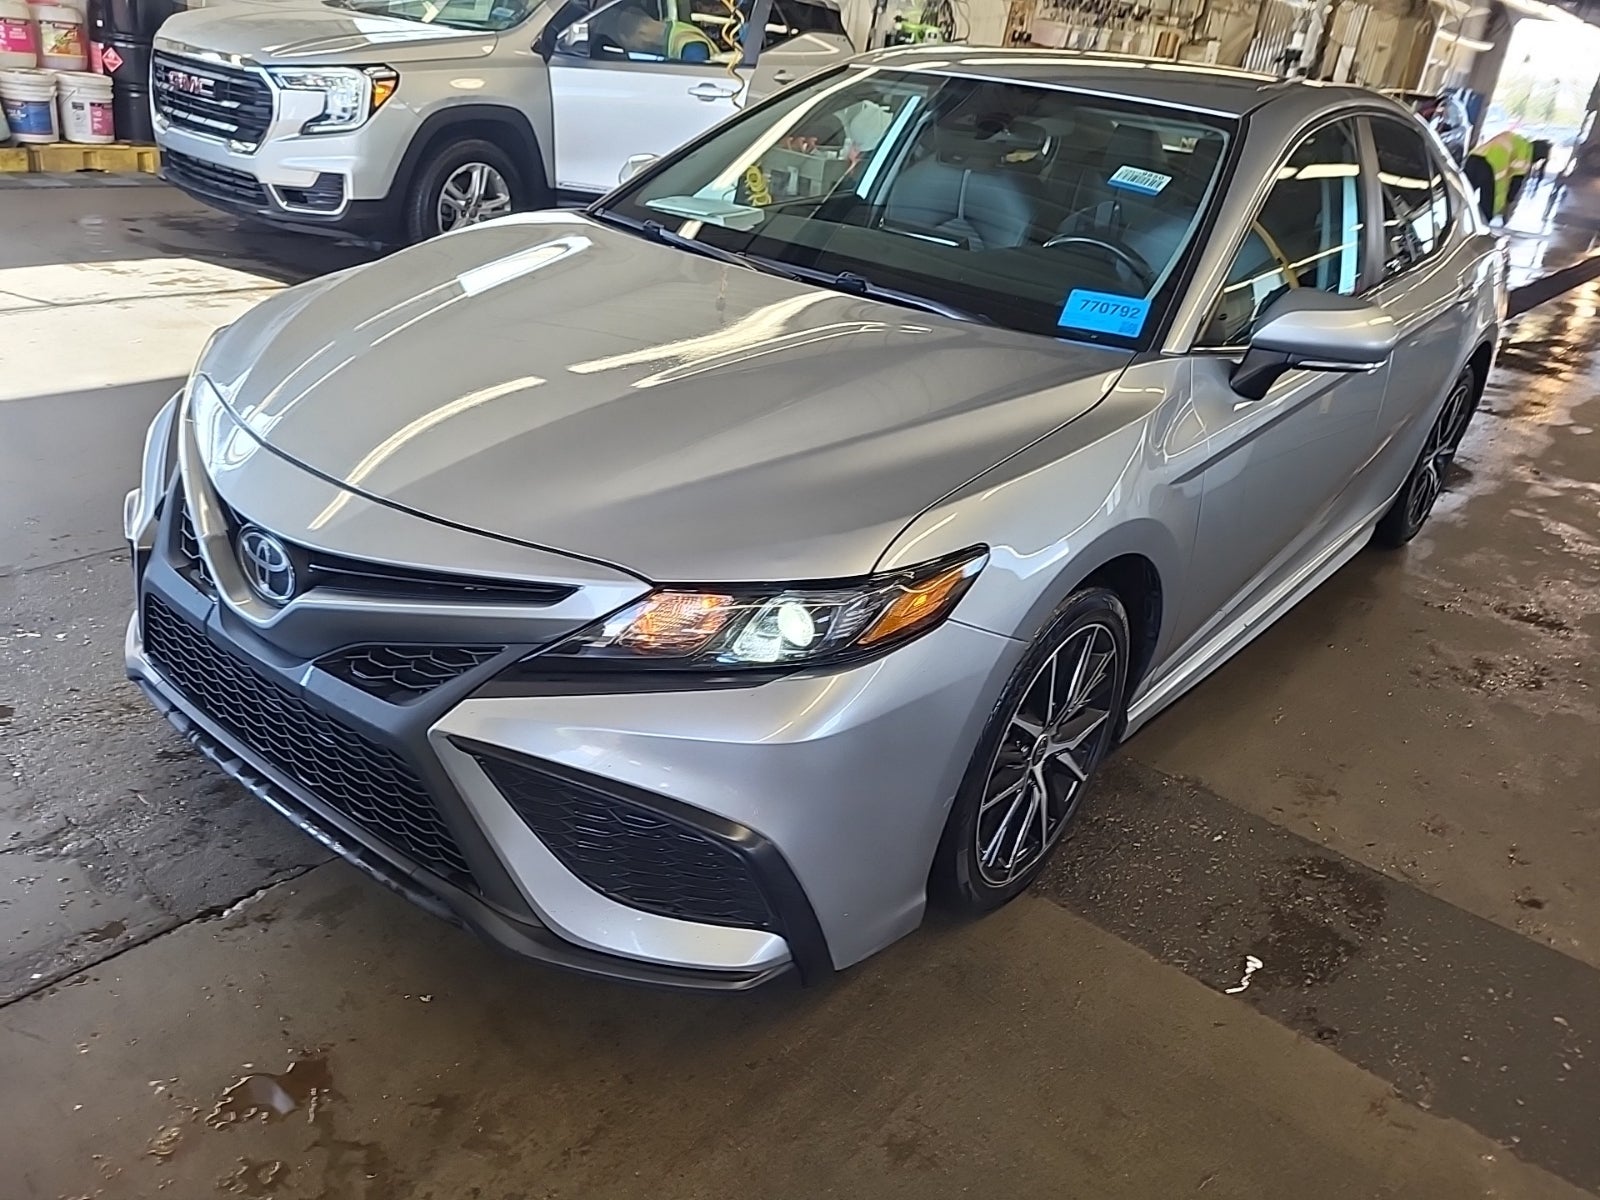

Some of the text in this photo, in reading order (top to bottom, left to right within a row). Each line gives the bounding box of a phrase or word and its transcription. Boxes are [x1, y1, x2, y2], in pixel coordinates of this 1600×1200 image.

[168, 70, 215, 97] GMC
[92, 110, 104, 130] 716
[1079, 299, 1142, 319] 770792
